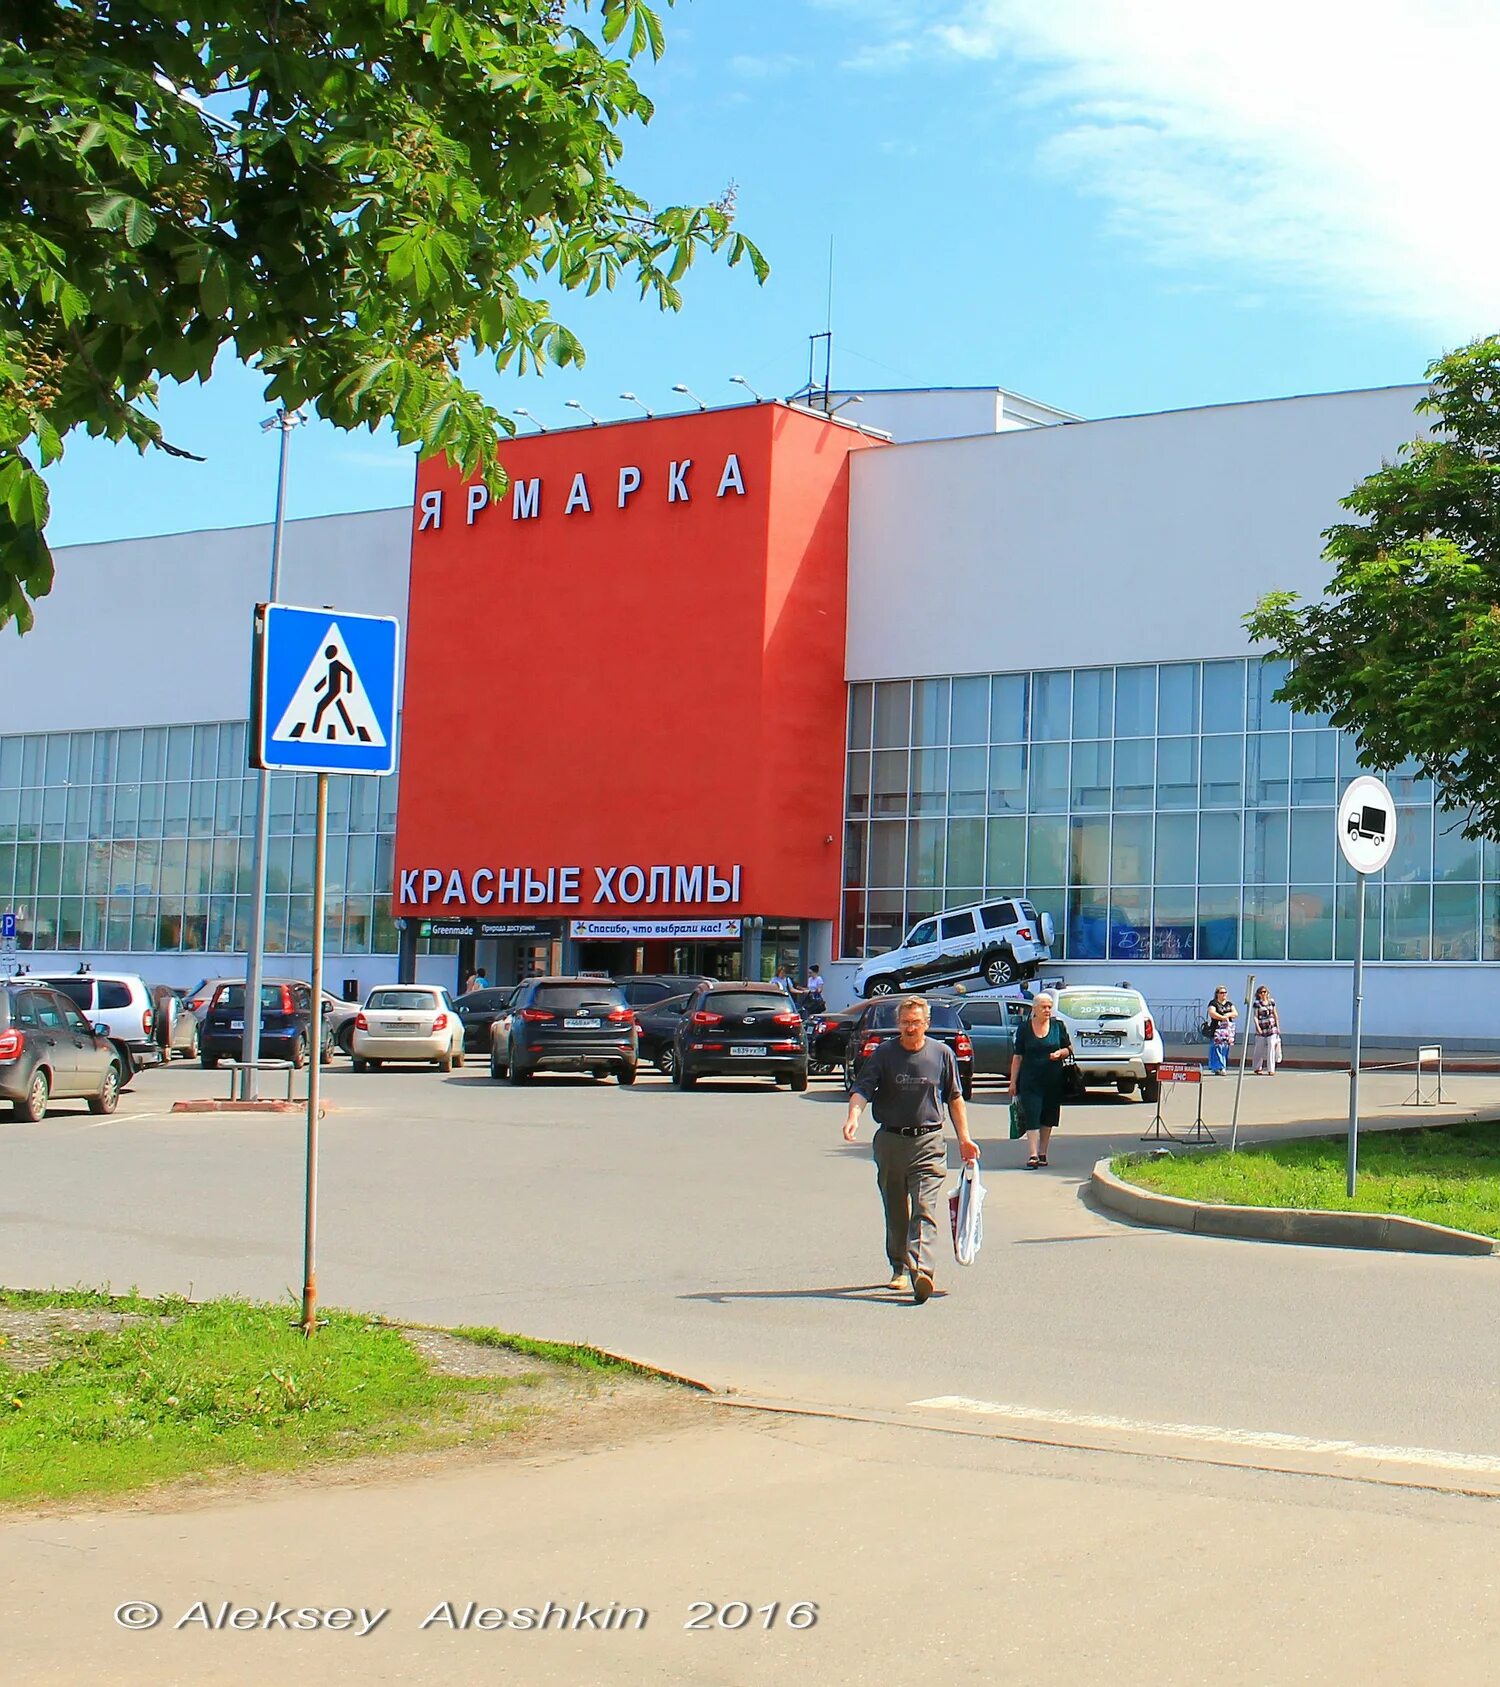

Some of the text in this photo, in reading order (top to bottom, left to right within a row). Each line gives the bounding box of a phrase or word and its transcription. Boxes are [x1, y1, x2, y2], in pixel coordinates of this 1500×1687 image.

[418, 453, 746, 531] ЯРМАРКА
[400, 864, 741, 905] КРАСНЫЕ ХОЛМЫ
[432, 924, 474, 935] Greenmade
[588, 922, 722, 935] Спасибо, что выбрали нас!
[1081, 1006, 1121, 1014] 20-33-08
[1173, 1072, 1187, 1081] МЧС
